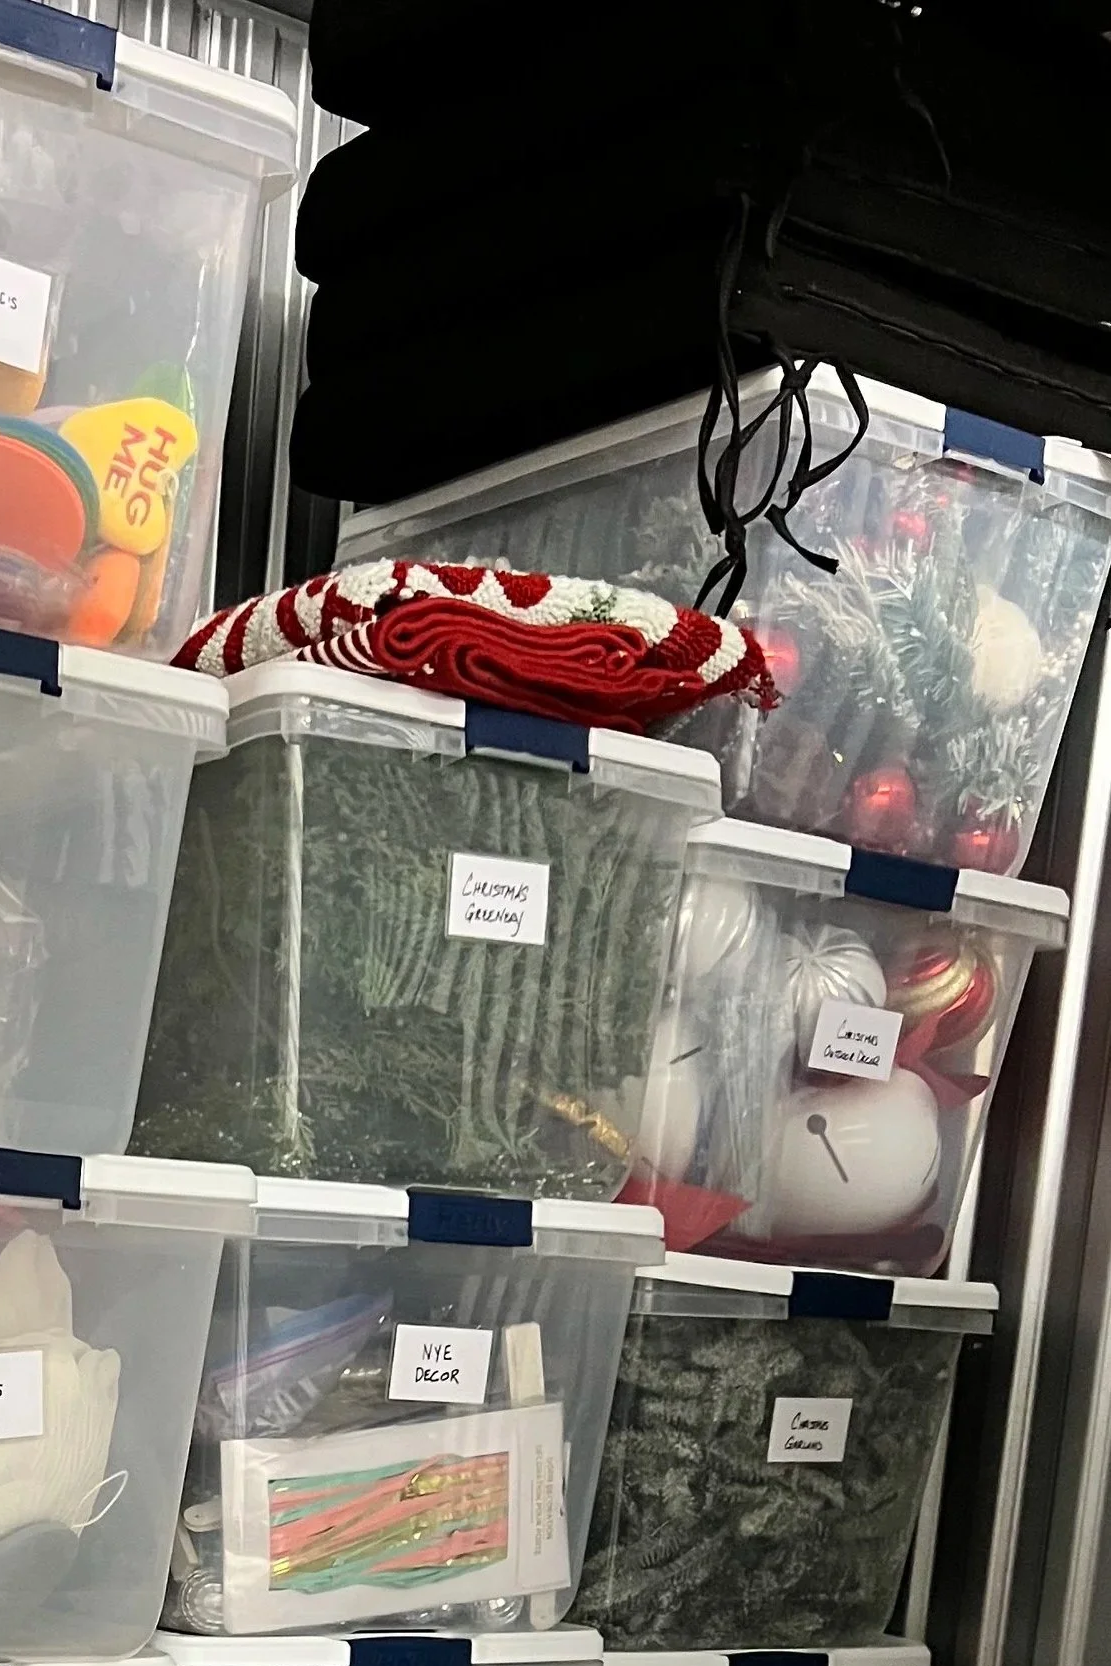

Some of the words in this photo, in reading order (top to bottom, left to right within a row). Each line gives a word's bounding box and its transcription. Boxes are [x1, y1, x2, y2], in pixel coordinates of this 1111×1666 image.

[103, 421, 147, 498] ME
[126, 426, 177, 526] HUG
[462, 872, 529, 902] CHRISTMAS
[422, 1343, 452, 1361] NYE
[415, 1368, 459, 1384] DECOR
